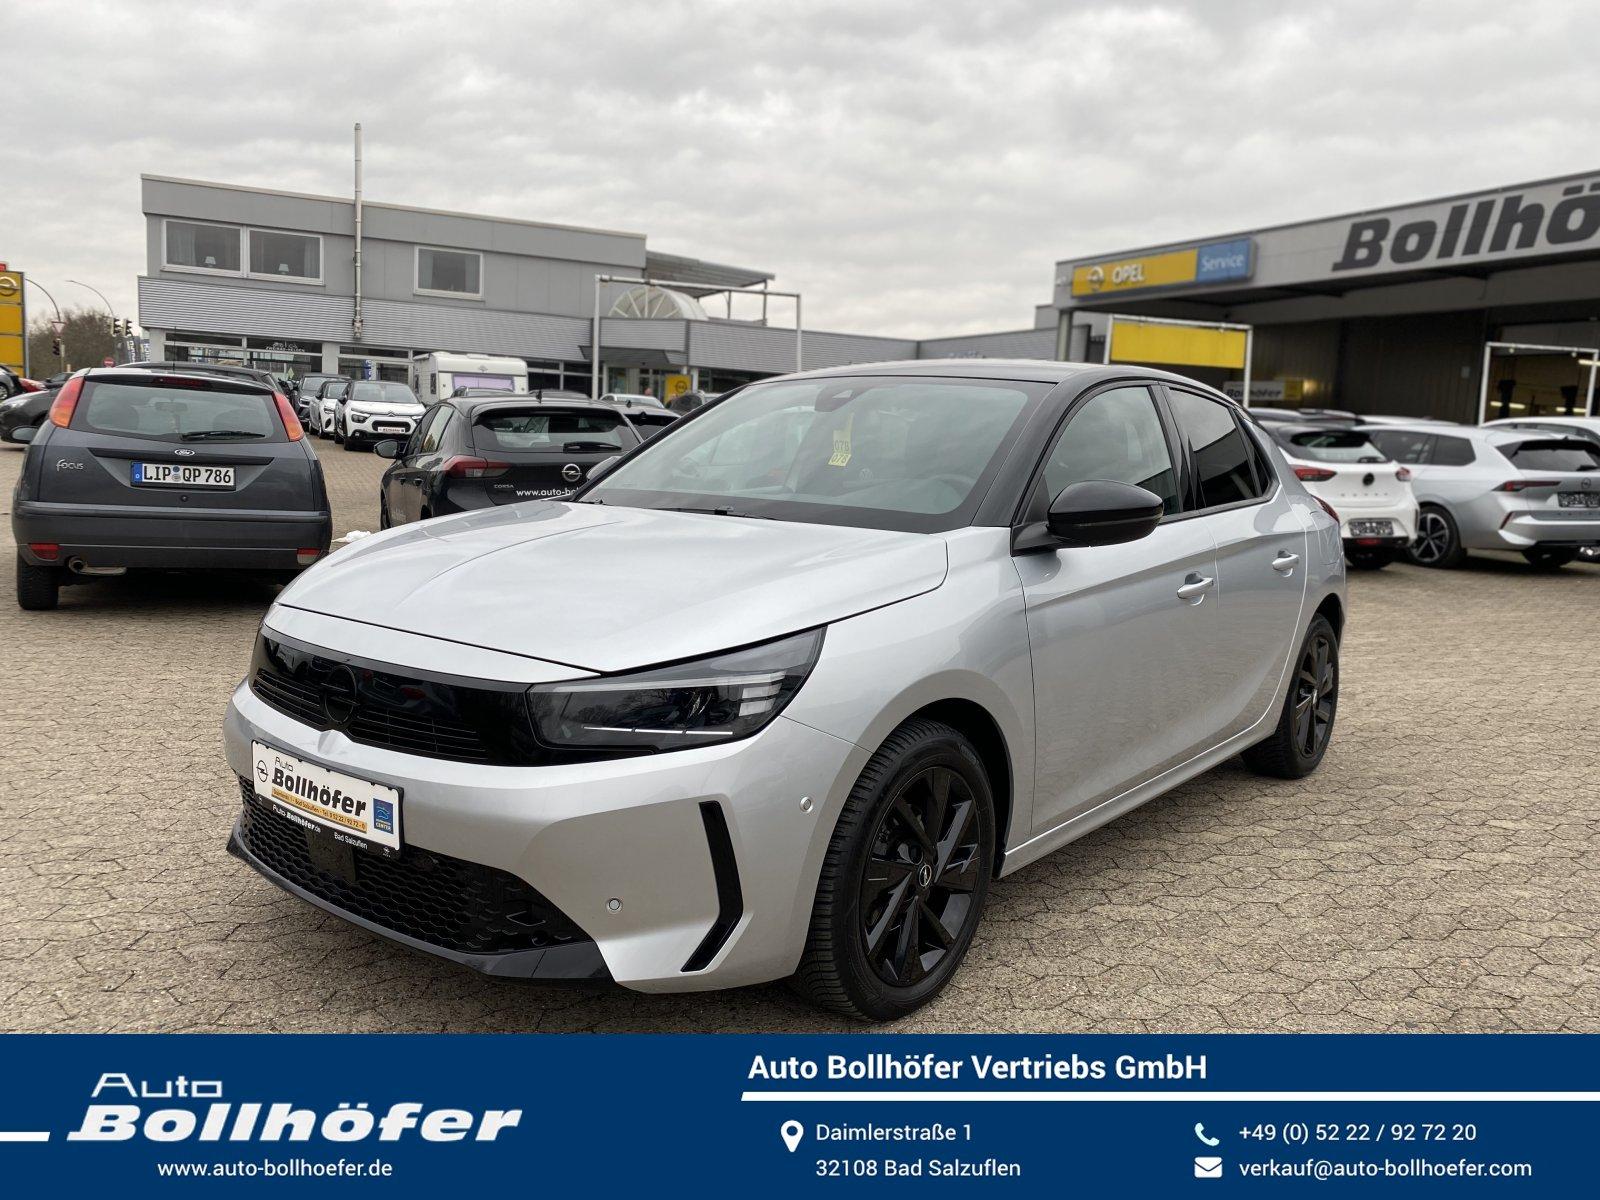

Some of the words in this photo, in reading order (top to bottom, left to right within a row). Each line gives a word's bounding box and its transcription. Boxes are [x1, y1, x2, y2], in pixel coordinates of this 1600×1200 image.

[1201, 253, 1244, 272] Service
[1112, 263, 1145, 284] OPEL
[143, 465, 170, 481] LIP
[182, 467, 201, 483] QP
[205, 469, 231, 484] 786
[274, 756, 294, 773] Auto
[272, 768, 367, 816] Bollhöfer
[334, 831, 344, 842] Bad
